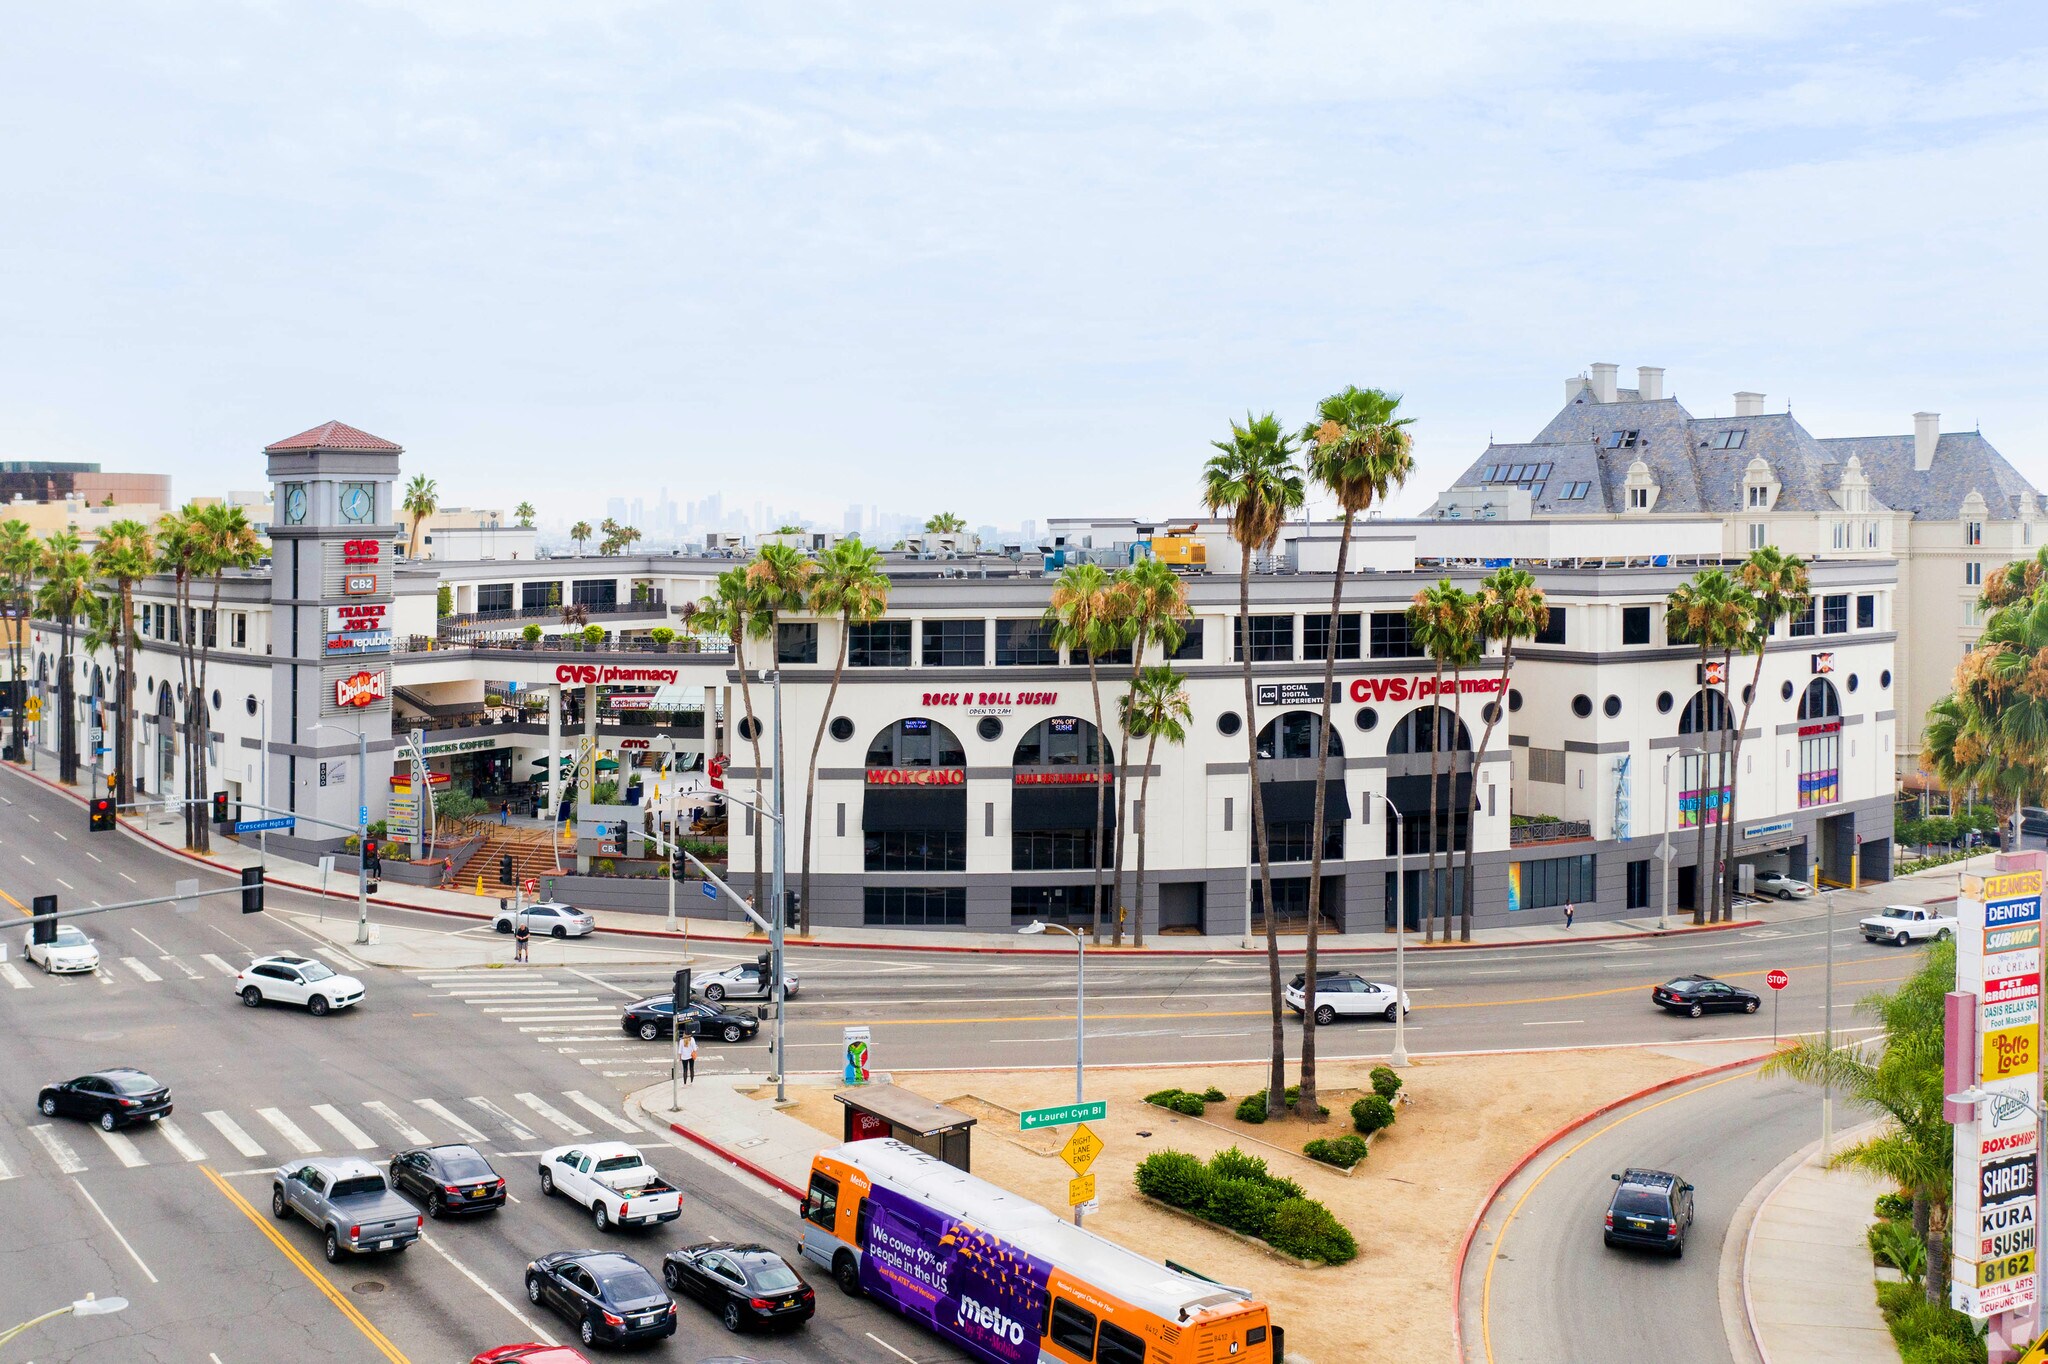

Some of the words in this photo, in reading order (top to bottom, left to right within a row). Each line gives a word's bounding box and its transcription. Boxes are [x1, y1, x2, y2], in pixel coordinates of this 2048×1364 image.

[344, 540, 380, 556] CVS
[350, 579, 373, 590] CB2
[338, 605, 386, 619] TRADER
[343, 618, 380, 631] JOE'S
[328, 631, 392, 653] salonrepublic
[556, 664, 679, 685] CVS/pharmacy
[336, 670, 386, 706] CRUNCH
[1350, 676, 1510, 703] CVS/pharmacy
[922, 692, 958, 706] ROCK
[963, 692, 974, 705] N
[979, 692, 1012, 705] ROLL
[1016, 692, 1058, 705] SUSHI
[398, 742, 458, 758] STBUCKS
[458, 738, 496, 750] COFFEE
[620, 739, 650, 750] amc
[867, 769, 964, 786] WOKCANO
[238, 821, 268, 831] Crescent
[269, 820, 284, 828] Hgts
[1986, 876, 2041, 898] CLEANERS
[1988, 902, 2036, 921] DENTIST
[1986, 928, 2038, 949] SUBWAY
[1987, 964, 2002, 976] ICE
[2006, 961, 2036, 972] CREAM
[1768, 976, 1787, 984] STOP
[1999, 978, 2023, 990] PET
[1986, 983, 2038, 1003] GROOMING
[1984, 1005, 2003, 1018] OASIS
[2005, 1002, 2024, 1015] RELAX
[2026, 999, 2038, 1012] SPA
[1990, 1017, 2004, 1028] Foot
[2005, 1014, 2032, 1027] Massage
[1992, 1038, 1998, 1047] El
[1998, 1034, 2029, 1055] Pollo
[1998, 1052, 2029, 1074] Loco
[1040, 1110, 1068, 1122] Laurel
[1072, 1108, 1088, 1118] Cyn
[862, 1120, 880, 1129] BOYS
[1072, 1136, 1091, 1146] RIGHT
[1073, 1145, 1090, 1156] LANE
[1073, 1154, 1090, 1164] ENDS
[850, 1174, 867, 1189] Metro
[1984, 1162, 2028, 1198] SHRED
[1982, 1205, 2032, 1232] KURA
[872, 1223, 888, 1243] We
[889, 1236, 916, 1259] cover
[916, 1247, 936, 1266] 99%
[936, 1260, 948, 1275] of
[1993, 1228, 2034, 1258] SUSHI
[870, 1243, 902, 1268] people
[904, 1258, 913, 1272] in
[914, 1263, 931, 1284] the
[932, 1272, 949, 1295] U.S.
[1984, 1255, 2029, 1283] 8162
[1980, 1283, 2011, 1300] MARTIAL
[2014, 1277, 2033, 1290] ARTS
[1980, 1291, 2034, 1314] ACUPUNCTURE
[958, 1294, 1025, 1346] metro
[1144, 1324, 1160, 1336] 8412
[1214, 1334, 1228, 1342] 8412
